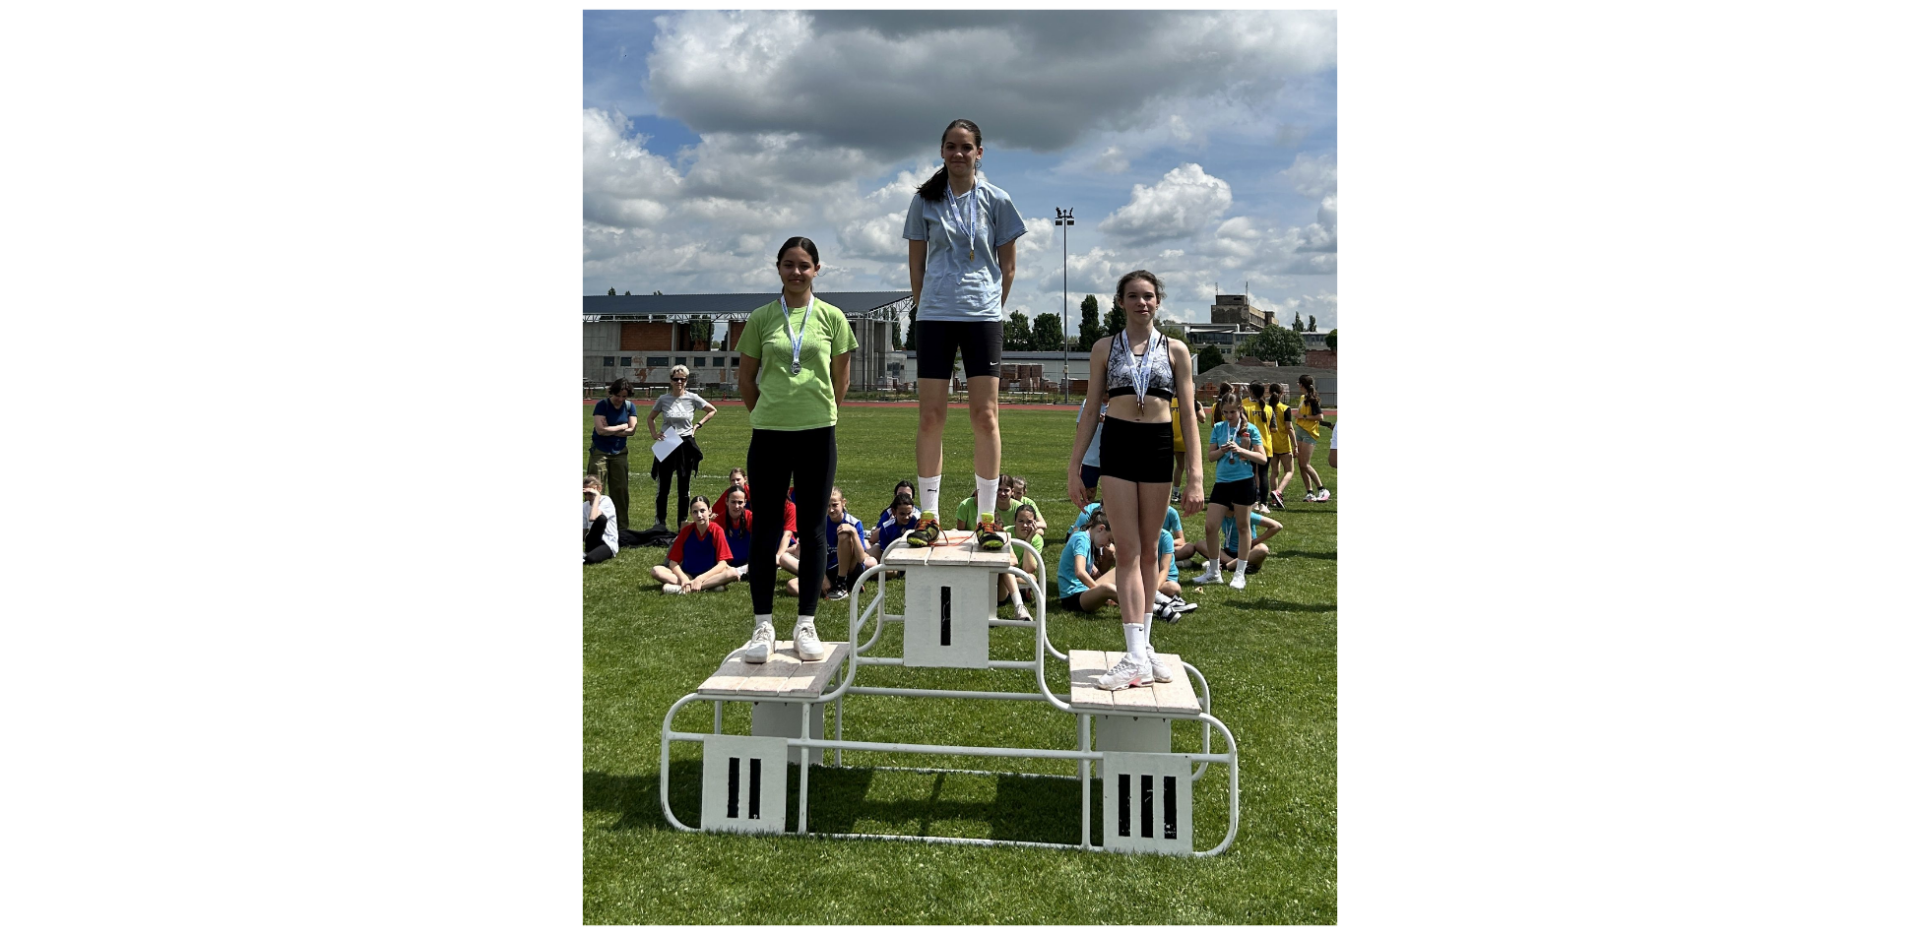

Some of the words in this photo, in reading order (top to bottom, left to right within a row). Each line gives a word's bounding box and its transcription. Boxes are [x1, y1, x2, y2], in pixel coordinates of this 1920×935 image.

[940, 586, 951, 646] I
[727, 757, 761, 819] II
[1117, 774, 1177, 840] III
